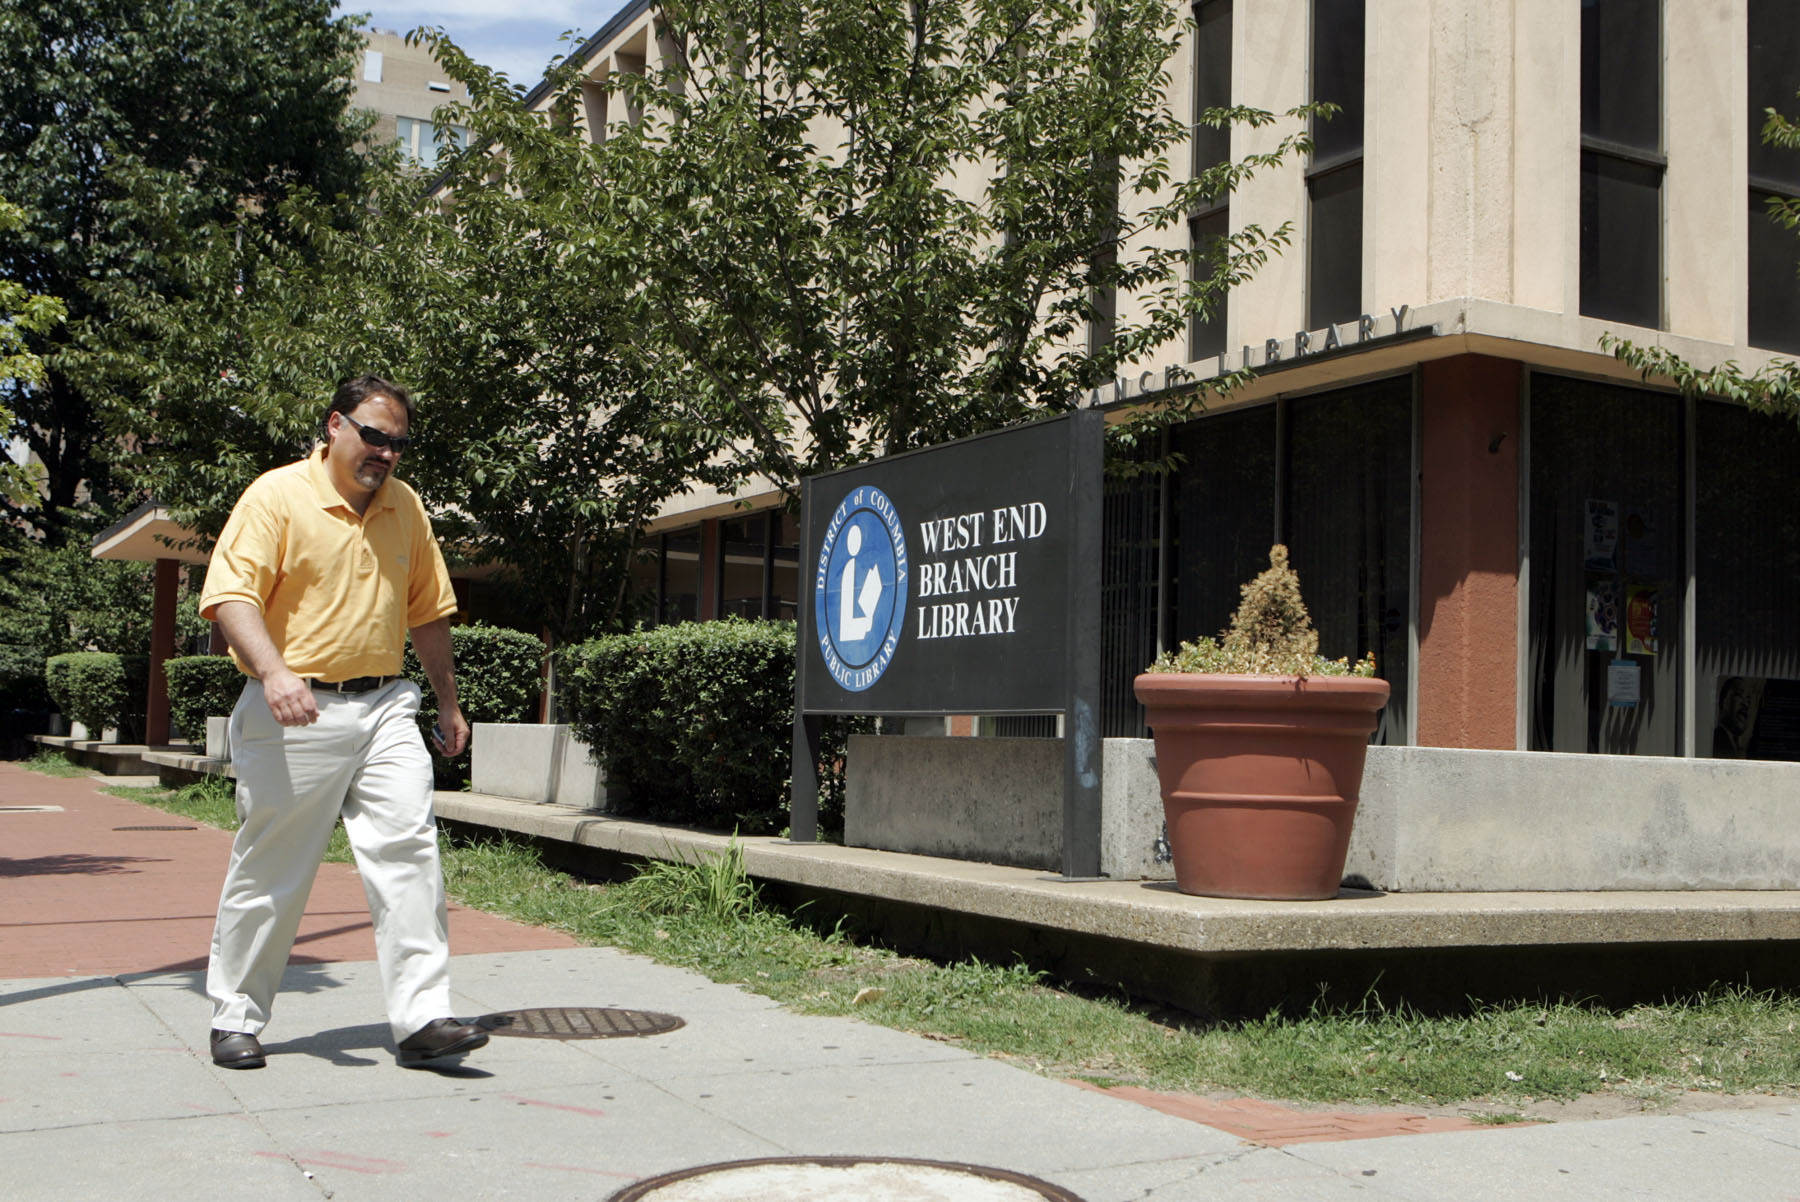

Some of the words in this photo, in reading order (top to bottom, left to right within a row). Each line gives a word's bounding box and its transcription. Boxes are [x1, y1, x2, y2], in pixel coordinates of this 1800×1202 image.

[1087, 363, 1180, 409] ANCH
[817, 502, 847, 589] DISTRICT
[854, 489, 864, 506] of
[870, 490, 906, 582] COLUMBIA
[920, 511, 985, 554] WEST
[992, 501, 1047, 544] END
[918, 551, 1018, 597] BRANCH
[917, 597, 1020, 640] LIBRARY
[821, 633, 852, 687] PUBLIC
[855, 629, 897, 688] LIBRARY
